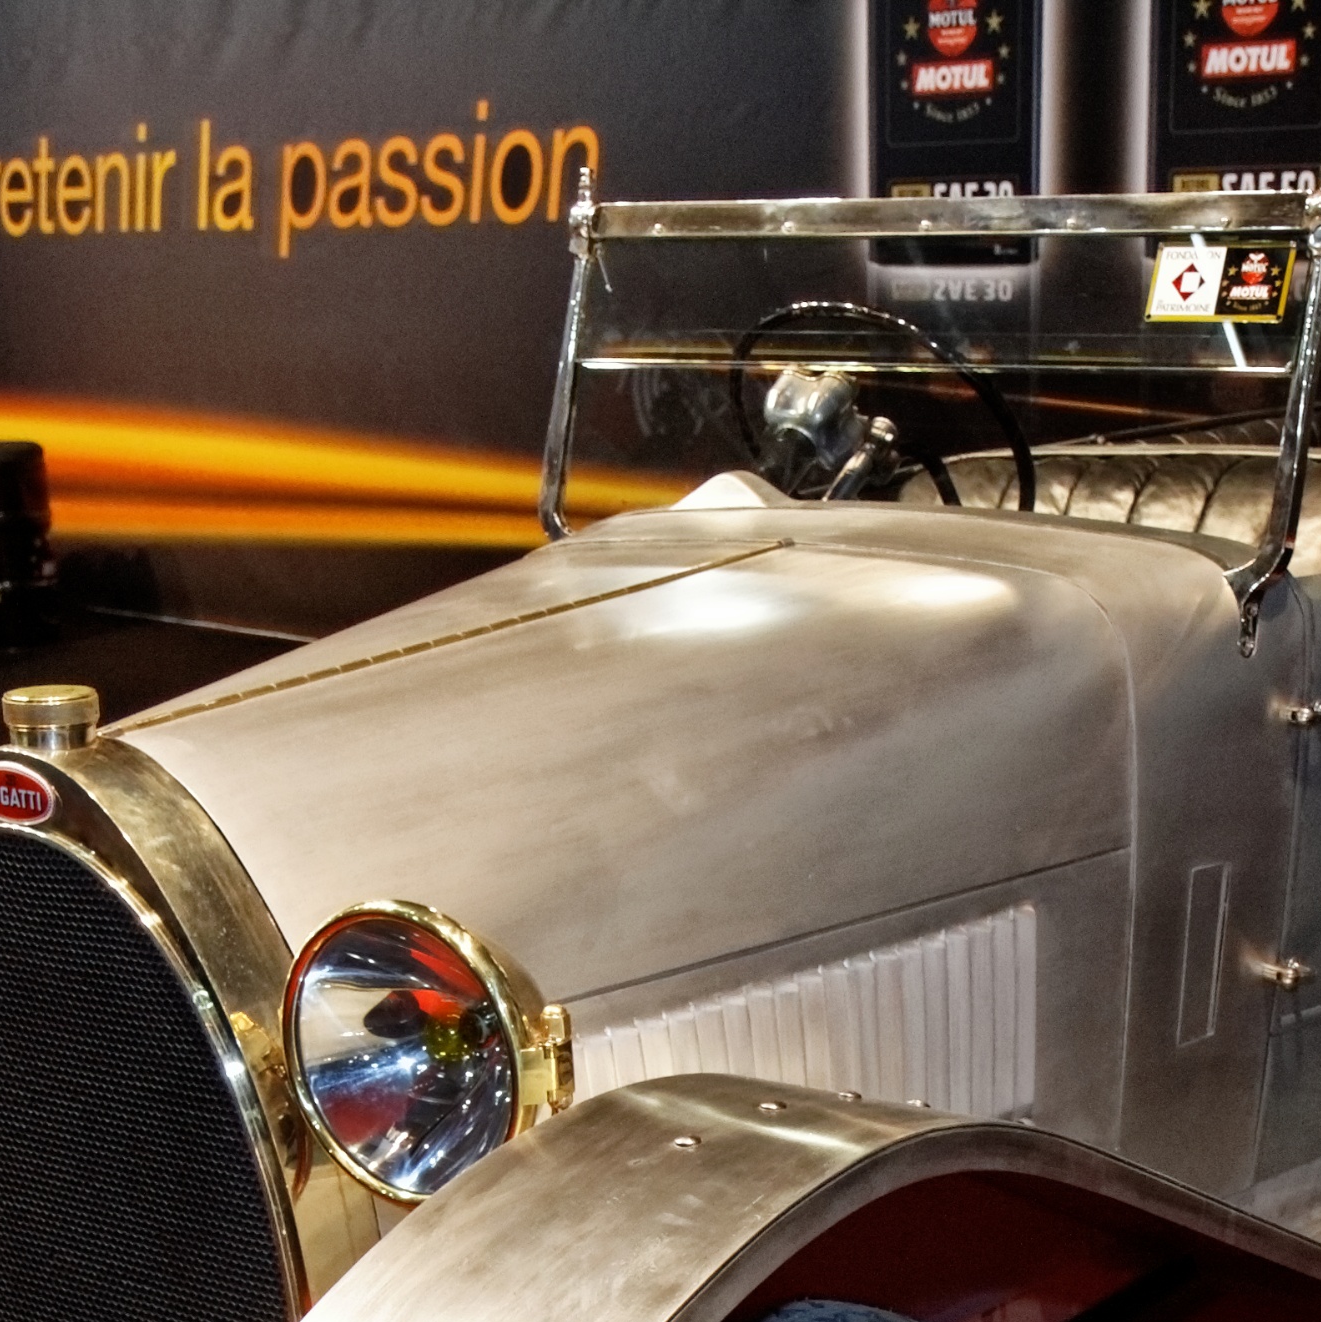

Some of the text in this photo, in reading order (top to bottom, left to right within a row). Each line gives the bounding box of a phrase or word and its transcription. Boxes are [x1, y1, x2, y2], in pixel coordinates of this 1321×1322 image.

[929, 9, 976, 28] MOTUL
[1204, 43, 1290, 74] MOTUL
[914, 64, 990, 92] MOTUL
[197, 119, 255, 231] la
[278, 100, 601, 260] passion
[1229, 285, 1270, 299] MOTUL
